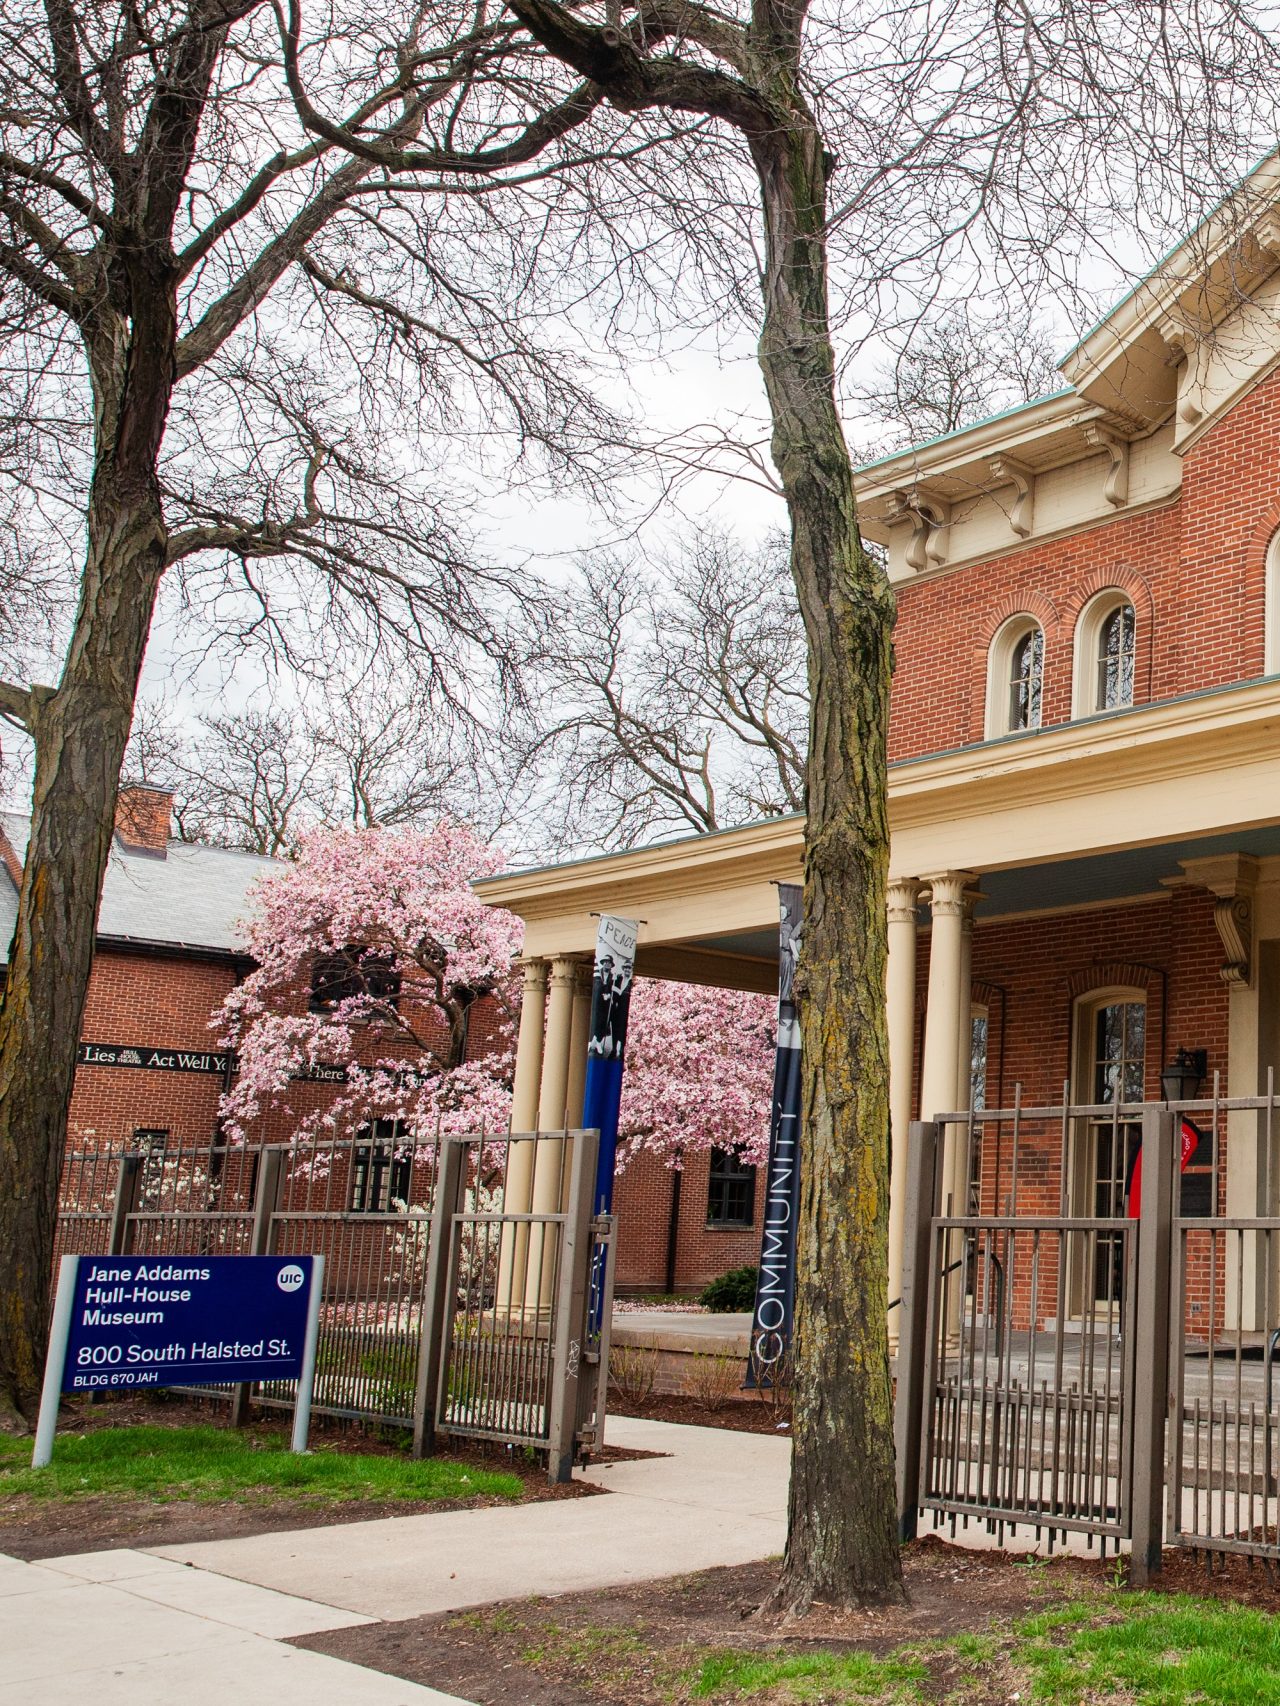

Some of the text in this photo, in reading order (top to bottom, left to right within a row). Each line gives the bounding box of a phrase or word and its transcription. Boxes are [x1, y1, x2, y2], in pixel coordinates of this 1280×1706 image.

[84, 1046, 116, 1063] Lies
[147, 1052, 175, 1067] Act
[177, 1053, 210, 1070] Well
[755, 1101, 797, 1365] COMMUNITY
[87, 1265, 211, 1282] Jane Addams
[279, 1272, 302, 1285] UIC
[85, 1287, 191, 1303] Hull-House
[82, 1309, 164, 1326] Museum
[77, 1339, 291, 1365] 800 South Halsted St.
[73, 1372, 158, 1387] BLDG 670 JAH
